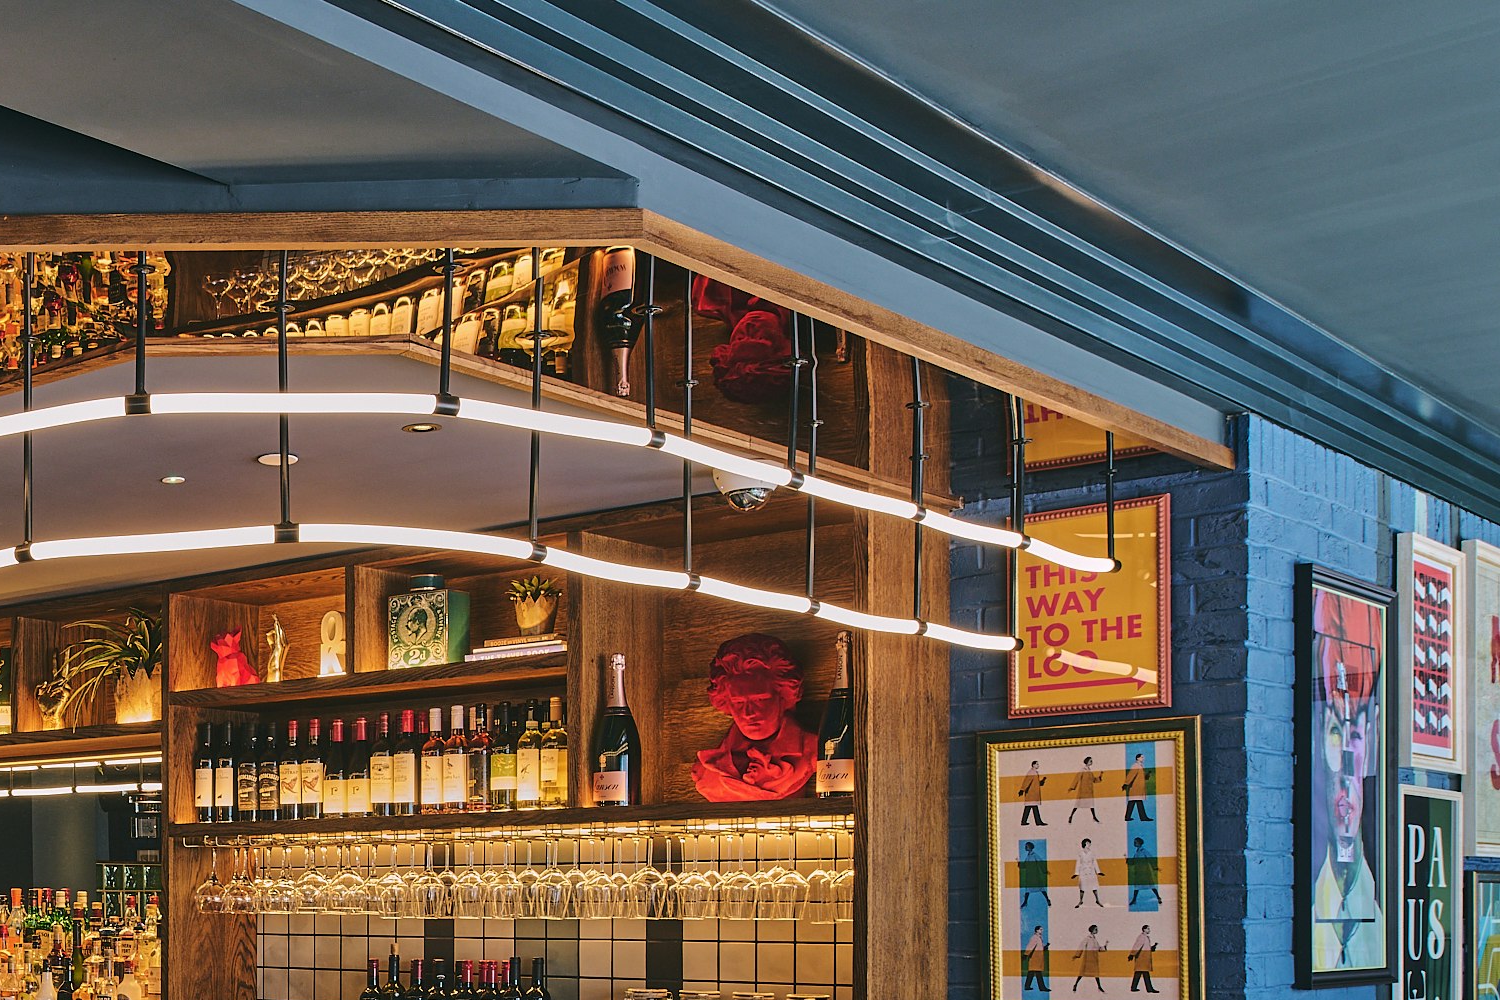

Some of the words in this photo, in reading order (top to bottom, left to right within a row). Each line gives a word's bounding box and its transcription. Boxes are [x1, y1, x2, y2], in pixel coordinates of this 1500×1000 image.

[1026, 587, 1105, 619] WAY
[1026, 622, 1070, 649] TO
[1081, 614, 1142, 643] THE
[1028, 650, 1100, 679] LOO
[818, 767, 849, 782] Lanson
